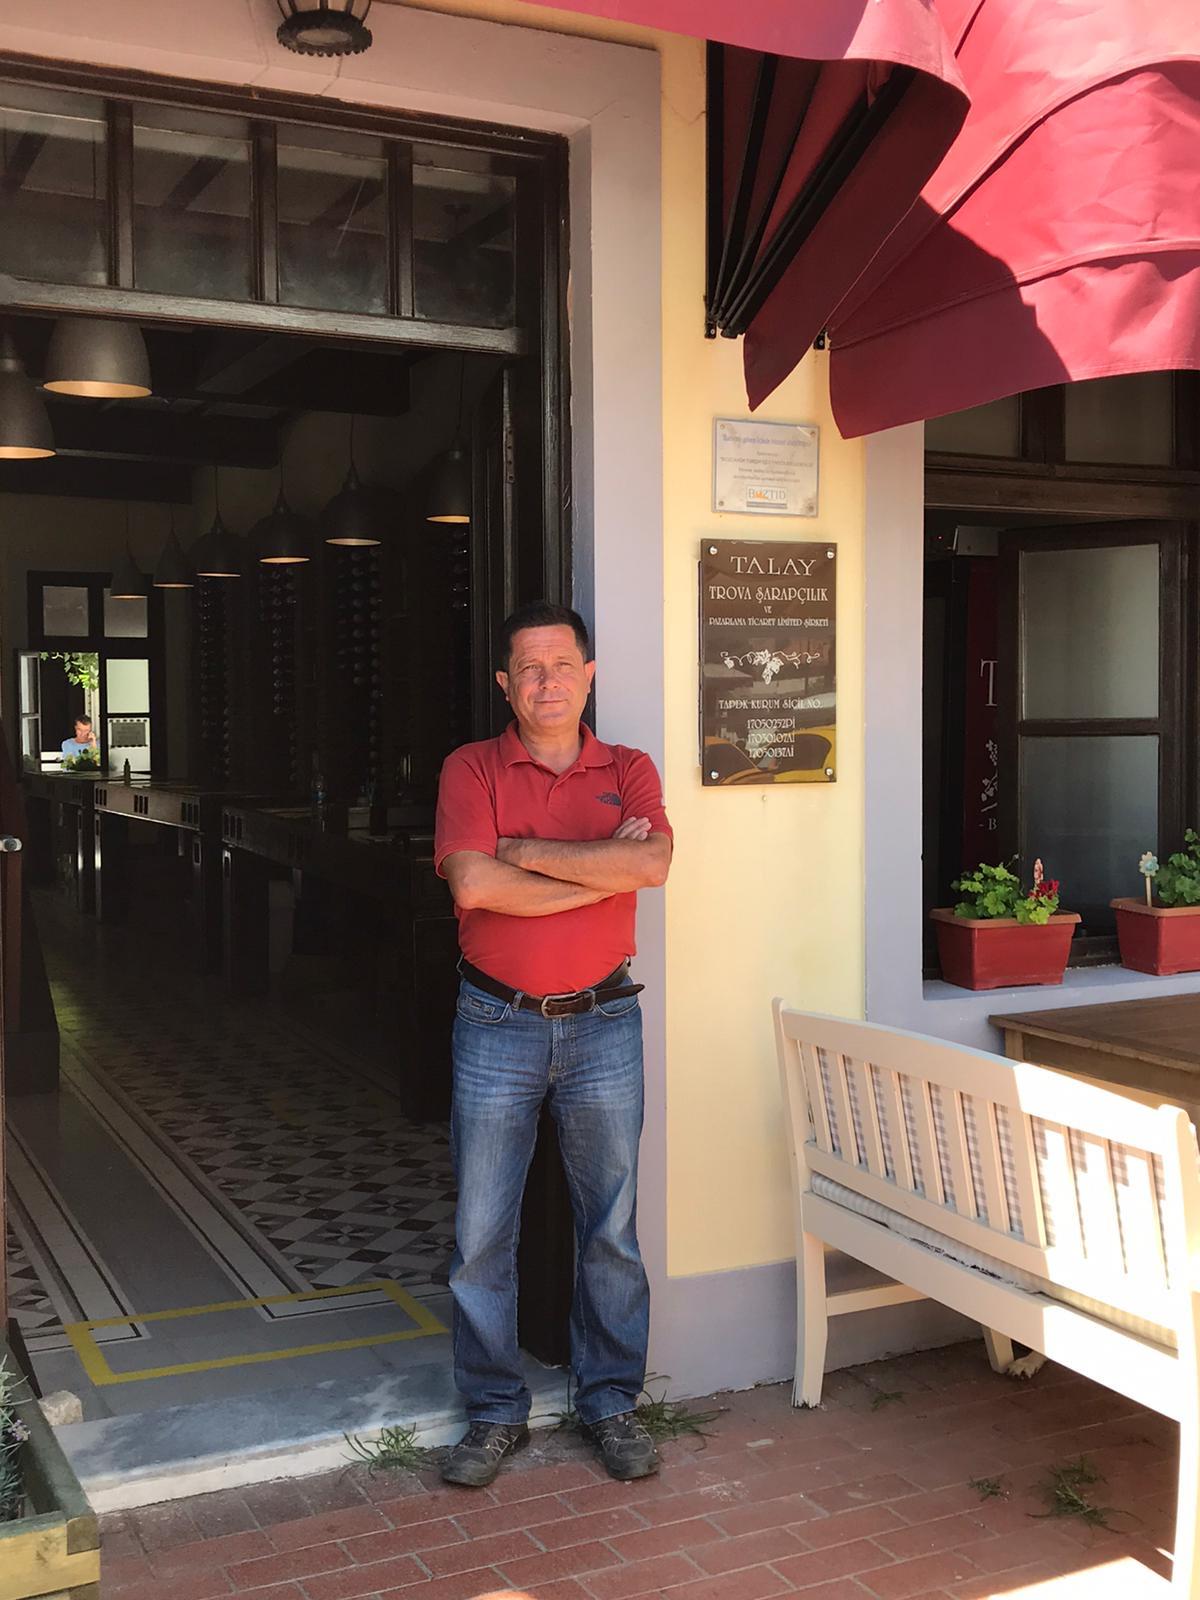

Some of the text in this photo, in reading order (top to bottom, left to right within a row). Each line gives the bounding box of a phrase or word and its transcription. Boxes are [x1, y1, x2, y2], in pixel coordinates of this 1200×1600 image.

[730, 556, 817, 576] TALAY
[708, 585, 752, 600] TROVA
[763, 606, 773, 614] VE
[708, 617, 747, 626] PAZARLAMA
[750, 699, 781, 712] KURUM
